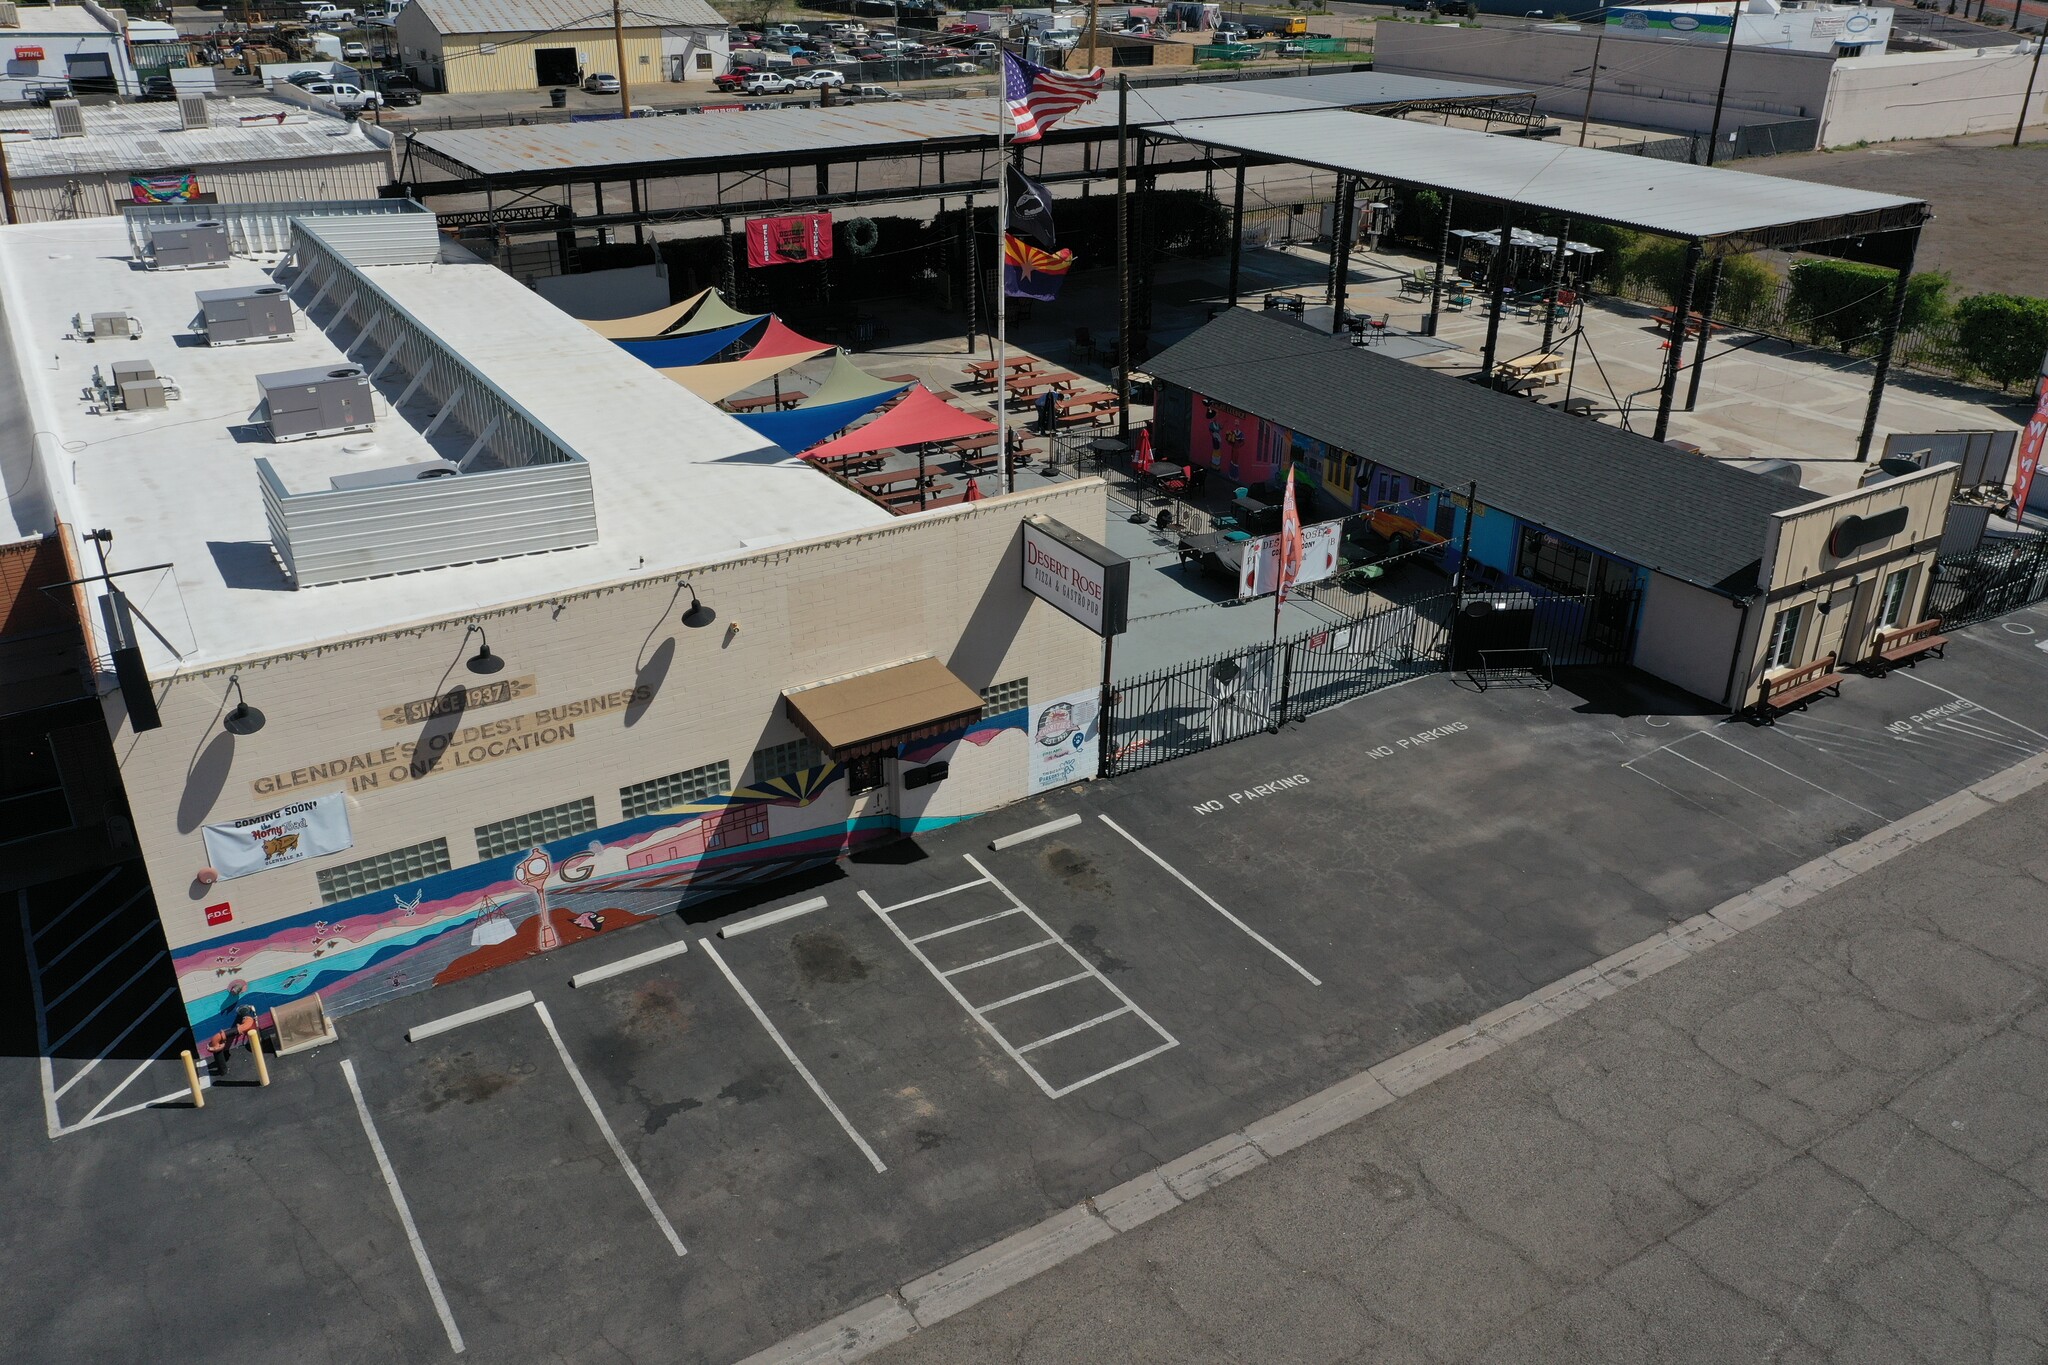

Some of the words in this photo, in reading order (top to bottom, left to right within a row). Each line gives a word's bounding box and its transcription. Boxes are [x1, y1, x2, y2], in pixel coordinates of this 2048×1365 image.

[762, 224, 770, 261] WELCOME
[1263, 537, 1279, 550] DES
[1027, 541, 1069, 580] DESERT
[1071, 568, 1102, 600] ROSE
[1035, 568, 1052, 588] PIZZA
[1055, 579, 1060, 592] &
[412, 695, 460, 720] SINCE
[466, 684, 504, 707] 1937
[1884, 720, 1913, 735] NO
[1909, 699, 1973, 725] PARKING
[254, 741, 417, 794] GLENDALE'S
[429, 714, 524, 751] OLDEST
[535, 685, 651, 726] BUSINESS
[1365, 745, 1394, 759] NO
[1396, 721, 1468, 749] PARKING
[351, 772, 378, 793] IN
[389, 757, 443, 782] ONE
[455, 723, 575, 767] LOCATION
[1192, 800, 1224, 815] NO
[1228, 774, 1310, 804] PARKING
[235, 810, 281, 829] COMING
[284, 801, 318, 816] SOON!
[251, 825, 283, 841] Horny
[260, 823, 272, 831] the
[265, 855, 294, 866] GLENDALE
[560, 851, 595, 882] G
